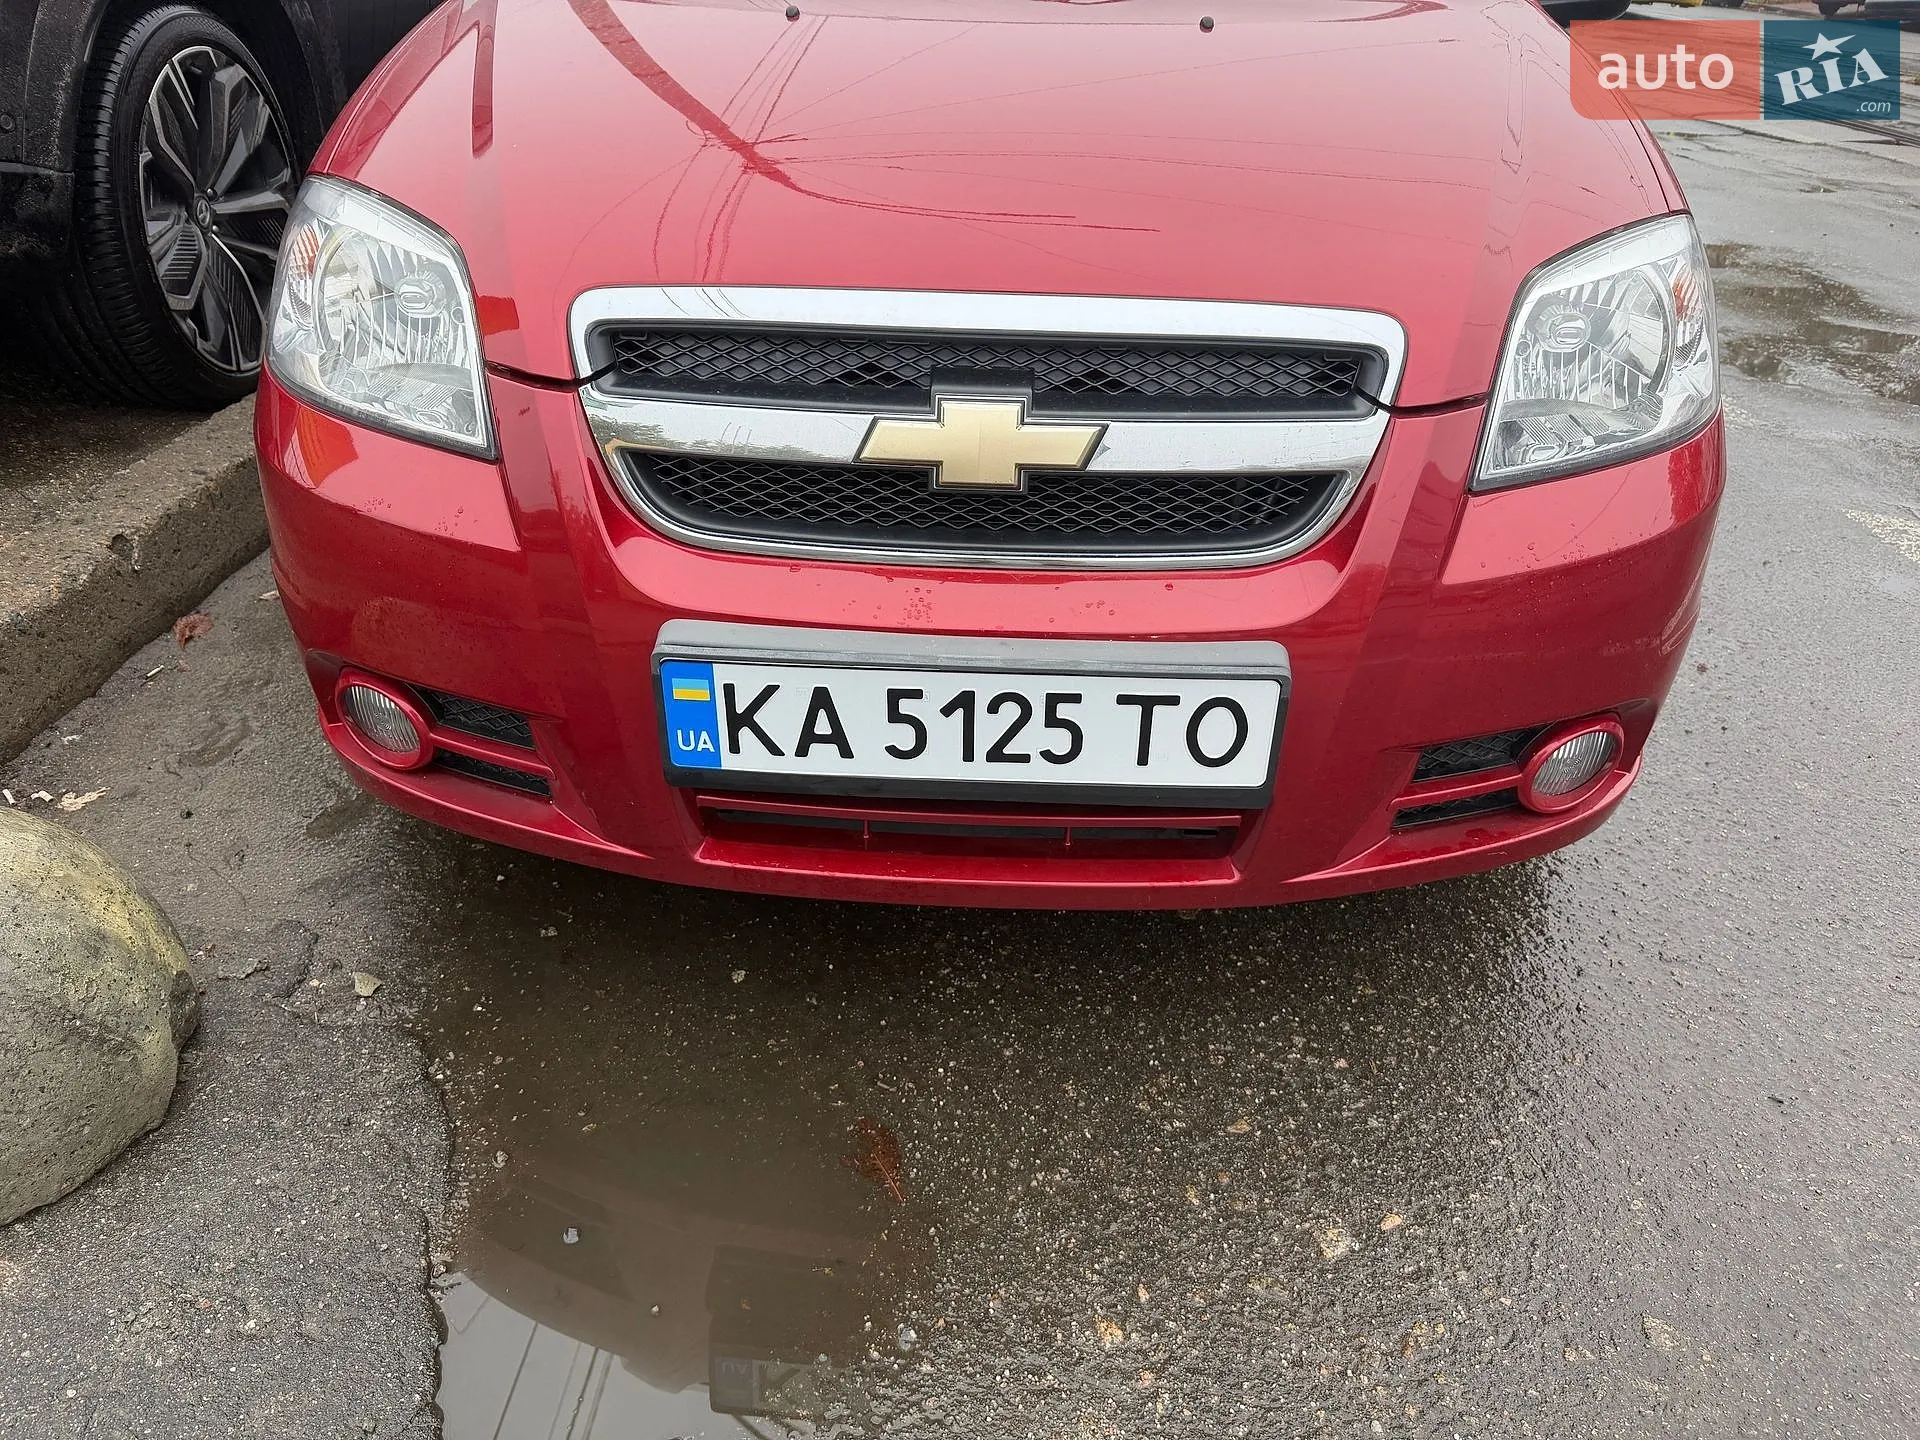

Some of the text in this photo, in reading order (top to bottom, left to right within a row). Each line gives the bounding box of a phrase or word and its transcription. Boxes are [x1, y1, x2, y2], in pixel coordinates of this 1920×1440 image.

[676, 728, 715, 753] UA
[722, 682, 1249, 768] KA 5125 TO
